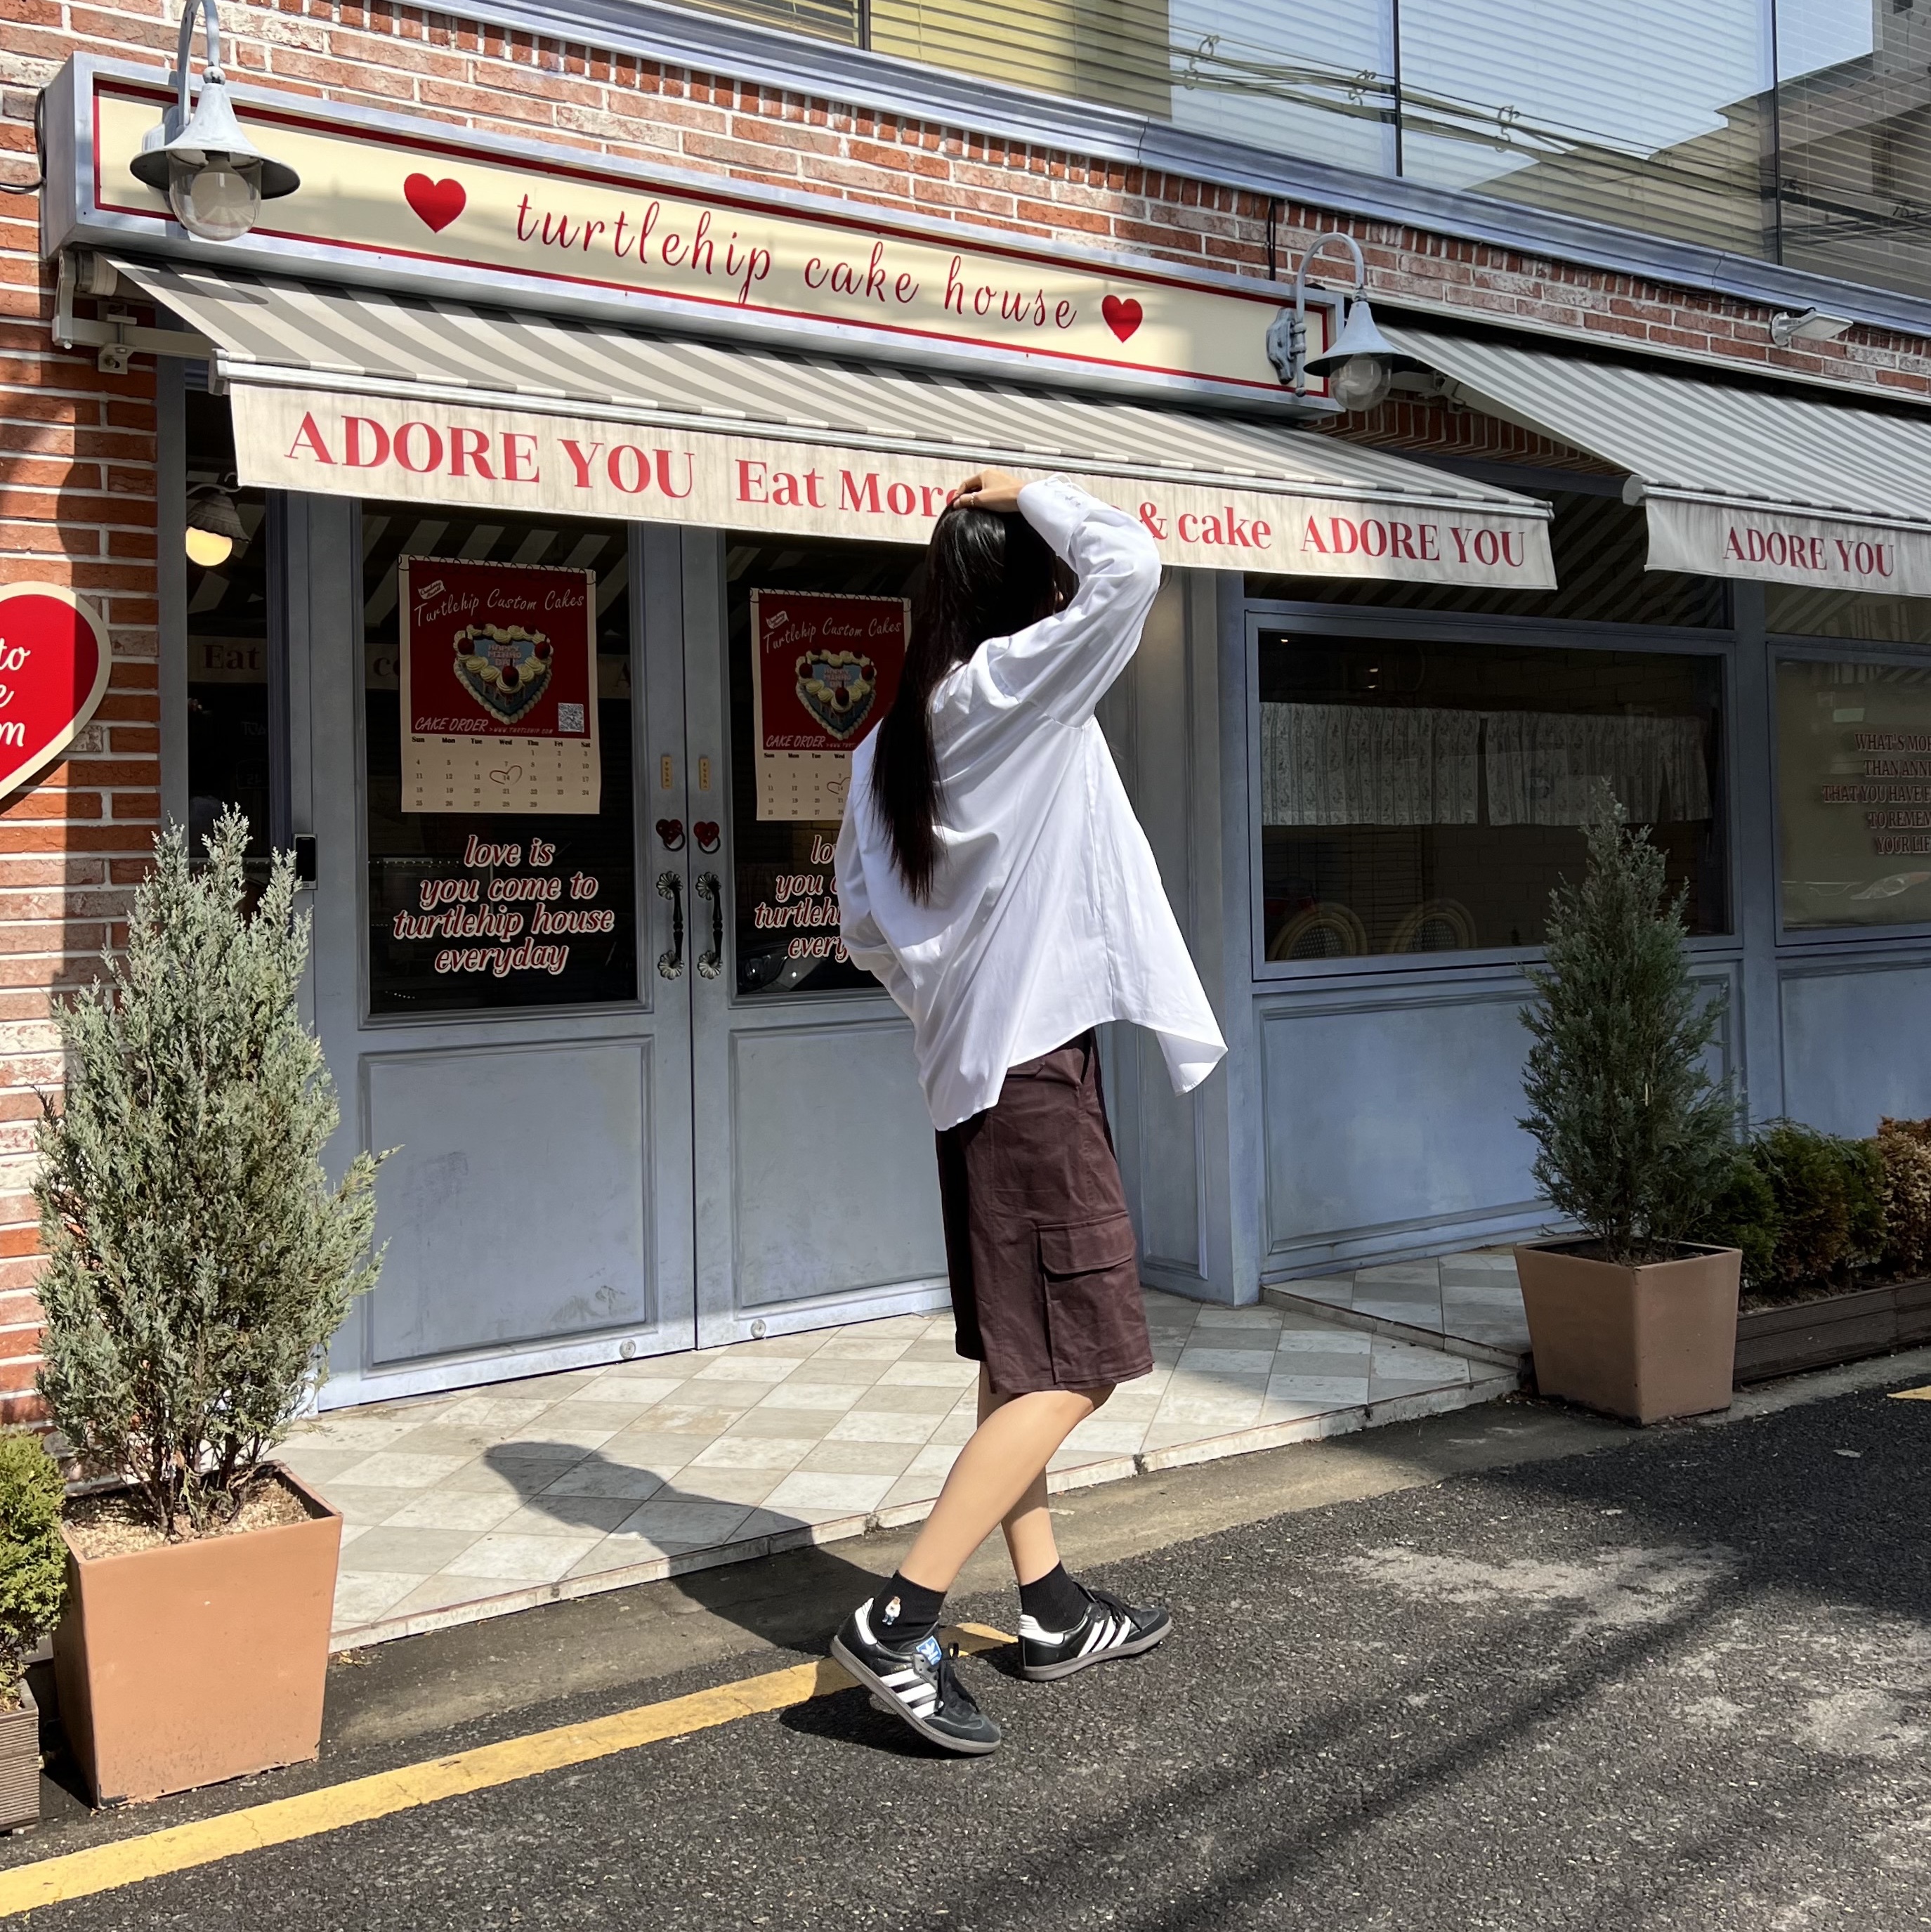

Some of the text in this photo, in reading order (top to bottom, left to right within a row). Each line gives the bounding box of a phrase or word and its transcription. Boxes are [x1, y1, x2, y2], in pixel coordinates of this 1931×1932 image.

[516, 193, 1077, 329] turtlehip cake house
[282, 410, 540, 485] ADORE
[556, 437, 696, 500] YOU
[735, 457, 827, 509] Eat
[1139, 502, 1168, 540] &
[1177, 506, 1271, 550] cake
[1300, 514, 1441, 562] ADORE
[1448, 525, 1526, 568] YOU
[1722, 526, 1894, 577] ADORE YOU
[414, 588, 584, 627] Turtlehip Custom Cakes
[763, 616, 902, 653] Turtlehip Custom Cakes
[203, 645, 261, 670] Eat
[414, 717, 449, 731] CAKE
[450, 719, 489, 732] ORDER
[766, 735, 794, 748] CAKE
[794, 736, 826, 748] ORDER
[1854, 734, 1905, 751] WHAT'S
[1864, 760, 1899, 776] THAN
[1823, 785, 1859, 802] THAT
[1861, 785, 1887, 802] YOU
[1889, 785, 1921, 802] HAVE
[1869, 811, 1886, 828] TO
[464, 834, 556, 867] love is
[811, 835, 837, 864] lo
[1877, 836, 1909, 853] YOUR
[419, 871, 598, 910] you come to
[775, 875, 823, 902] you
[393, 902, 615, 942] turtlehip house
[434, 936, 570, 978] everyday
